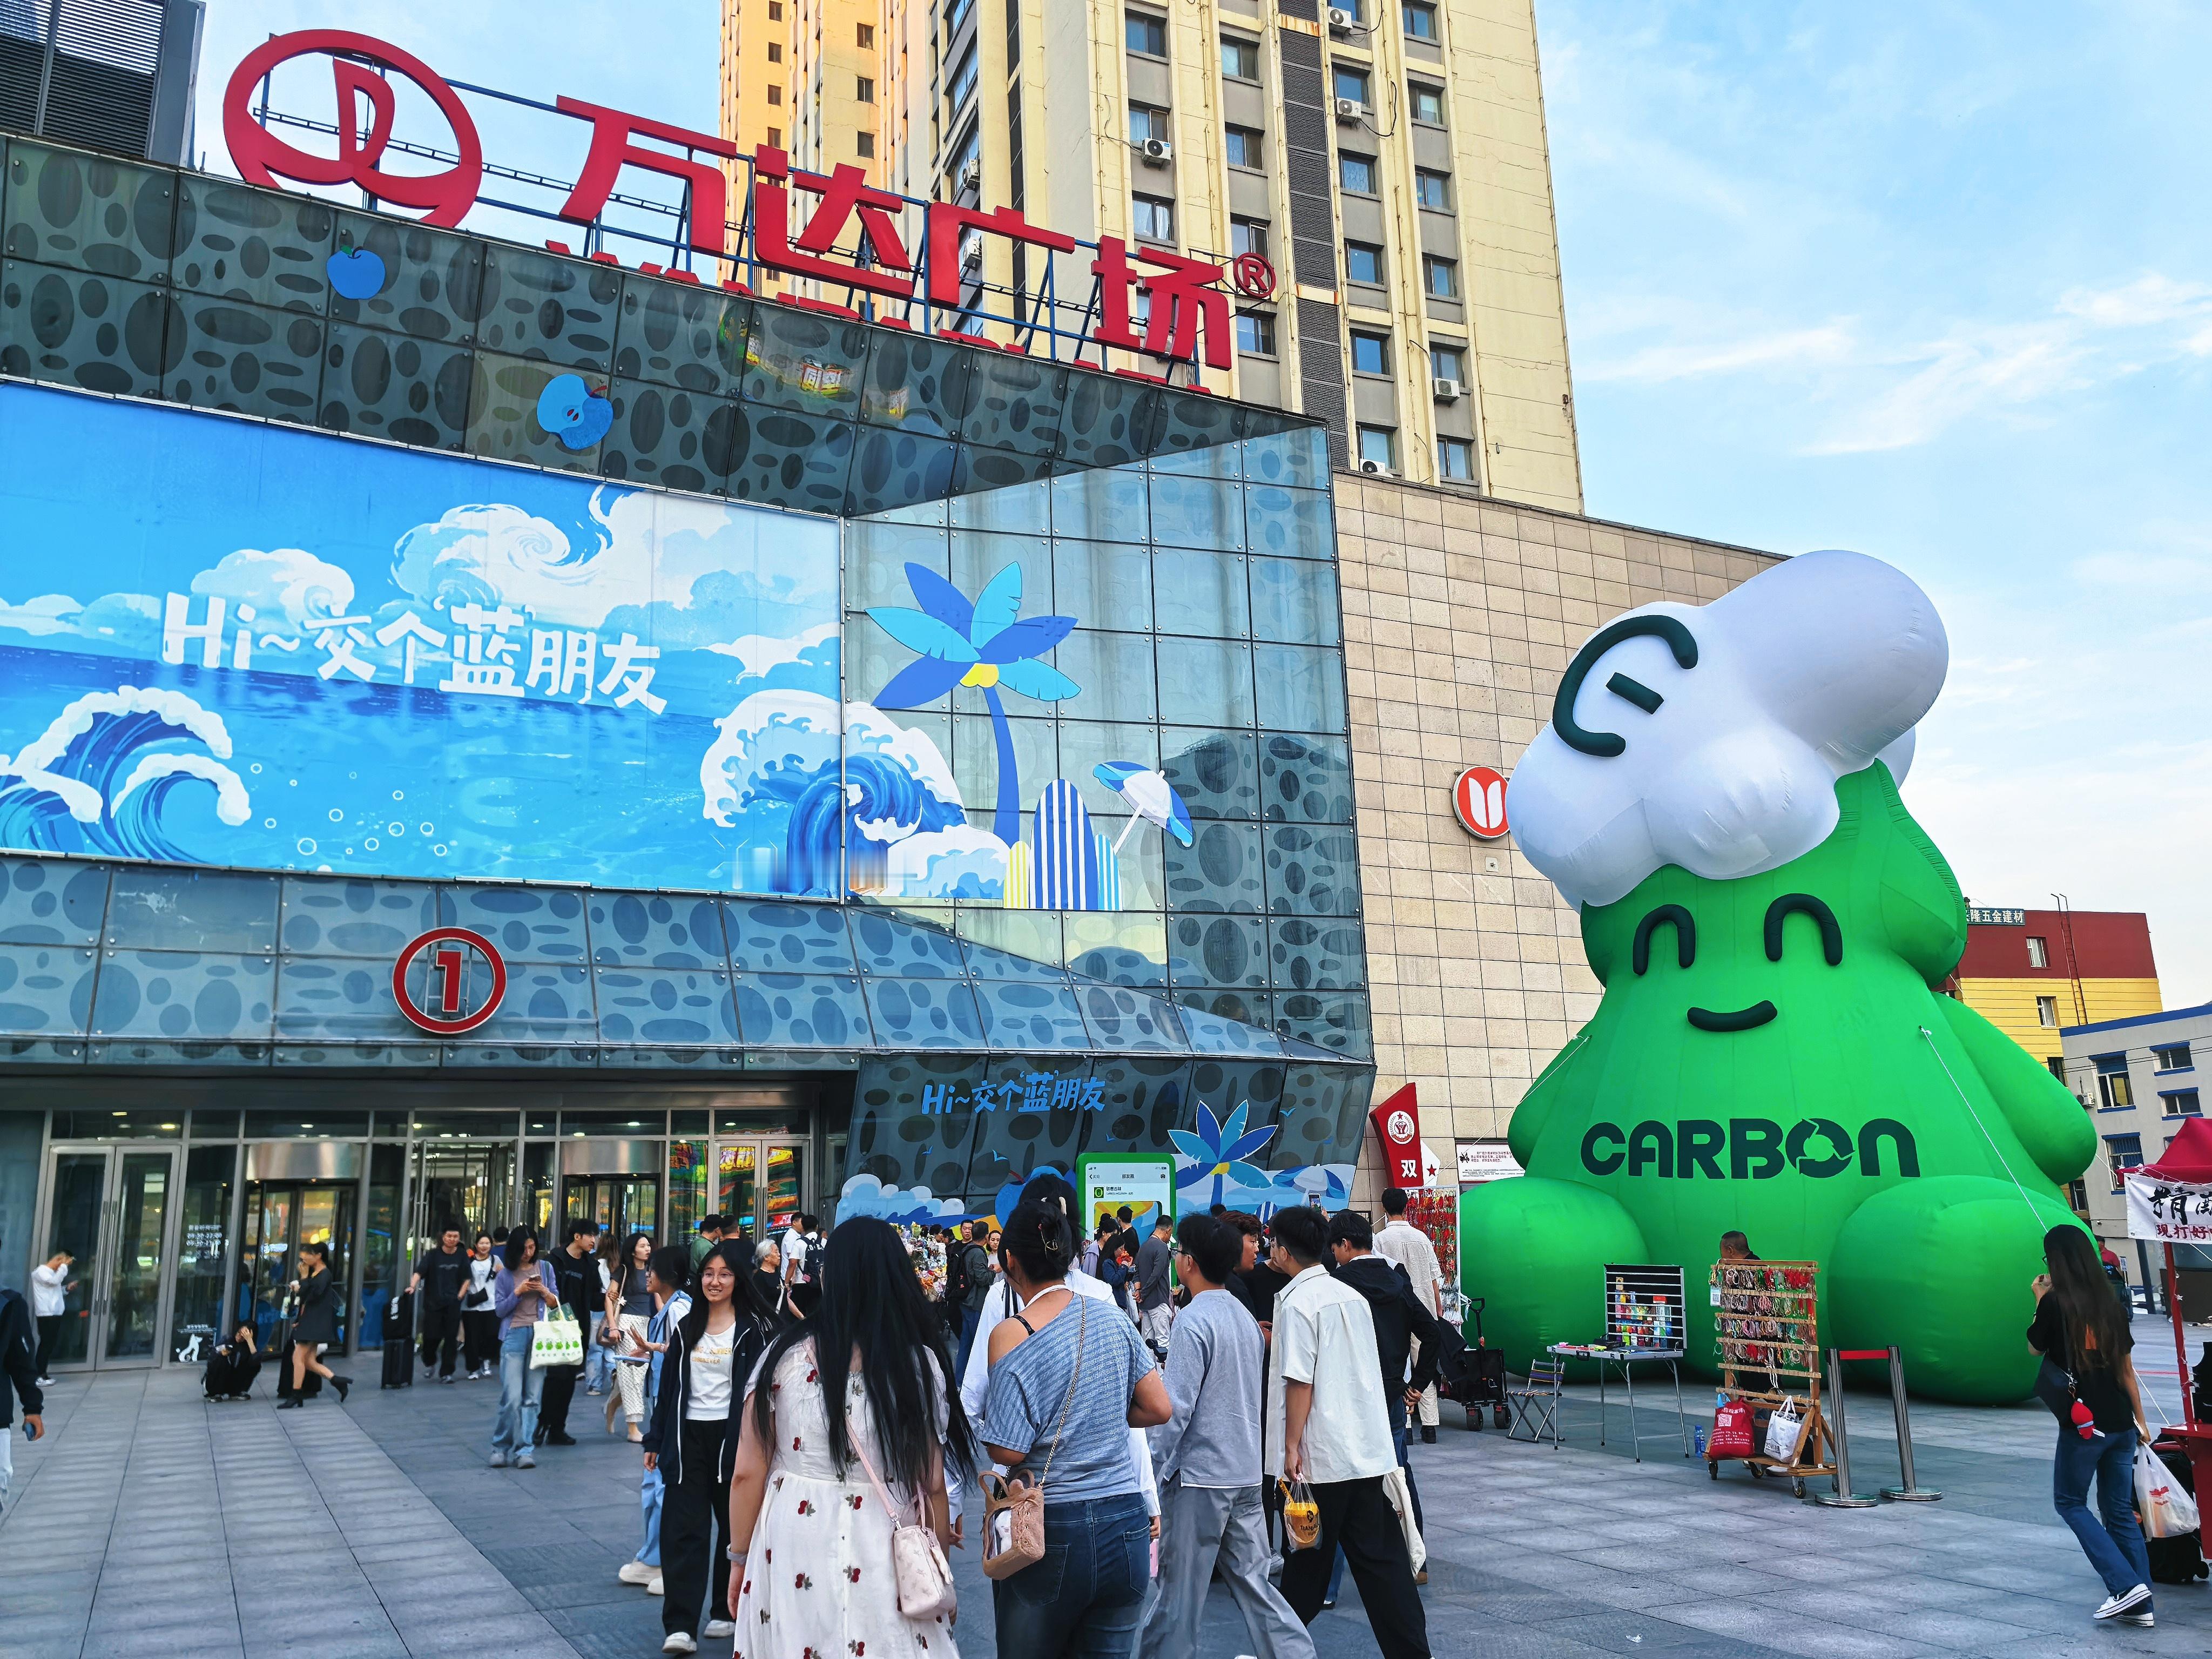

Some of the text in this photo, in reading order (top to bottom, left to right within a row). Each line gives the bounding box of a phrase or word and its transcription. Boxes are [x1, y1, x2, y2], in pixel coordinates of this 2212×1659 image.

[556, 95, 1232, 371] 万达广场
[1580, 1117, 1921, 1179] CARBON
[1400, 1159, 1418, 1178] 双
[2156, 1224, 2212, 1239] 现打好
